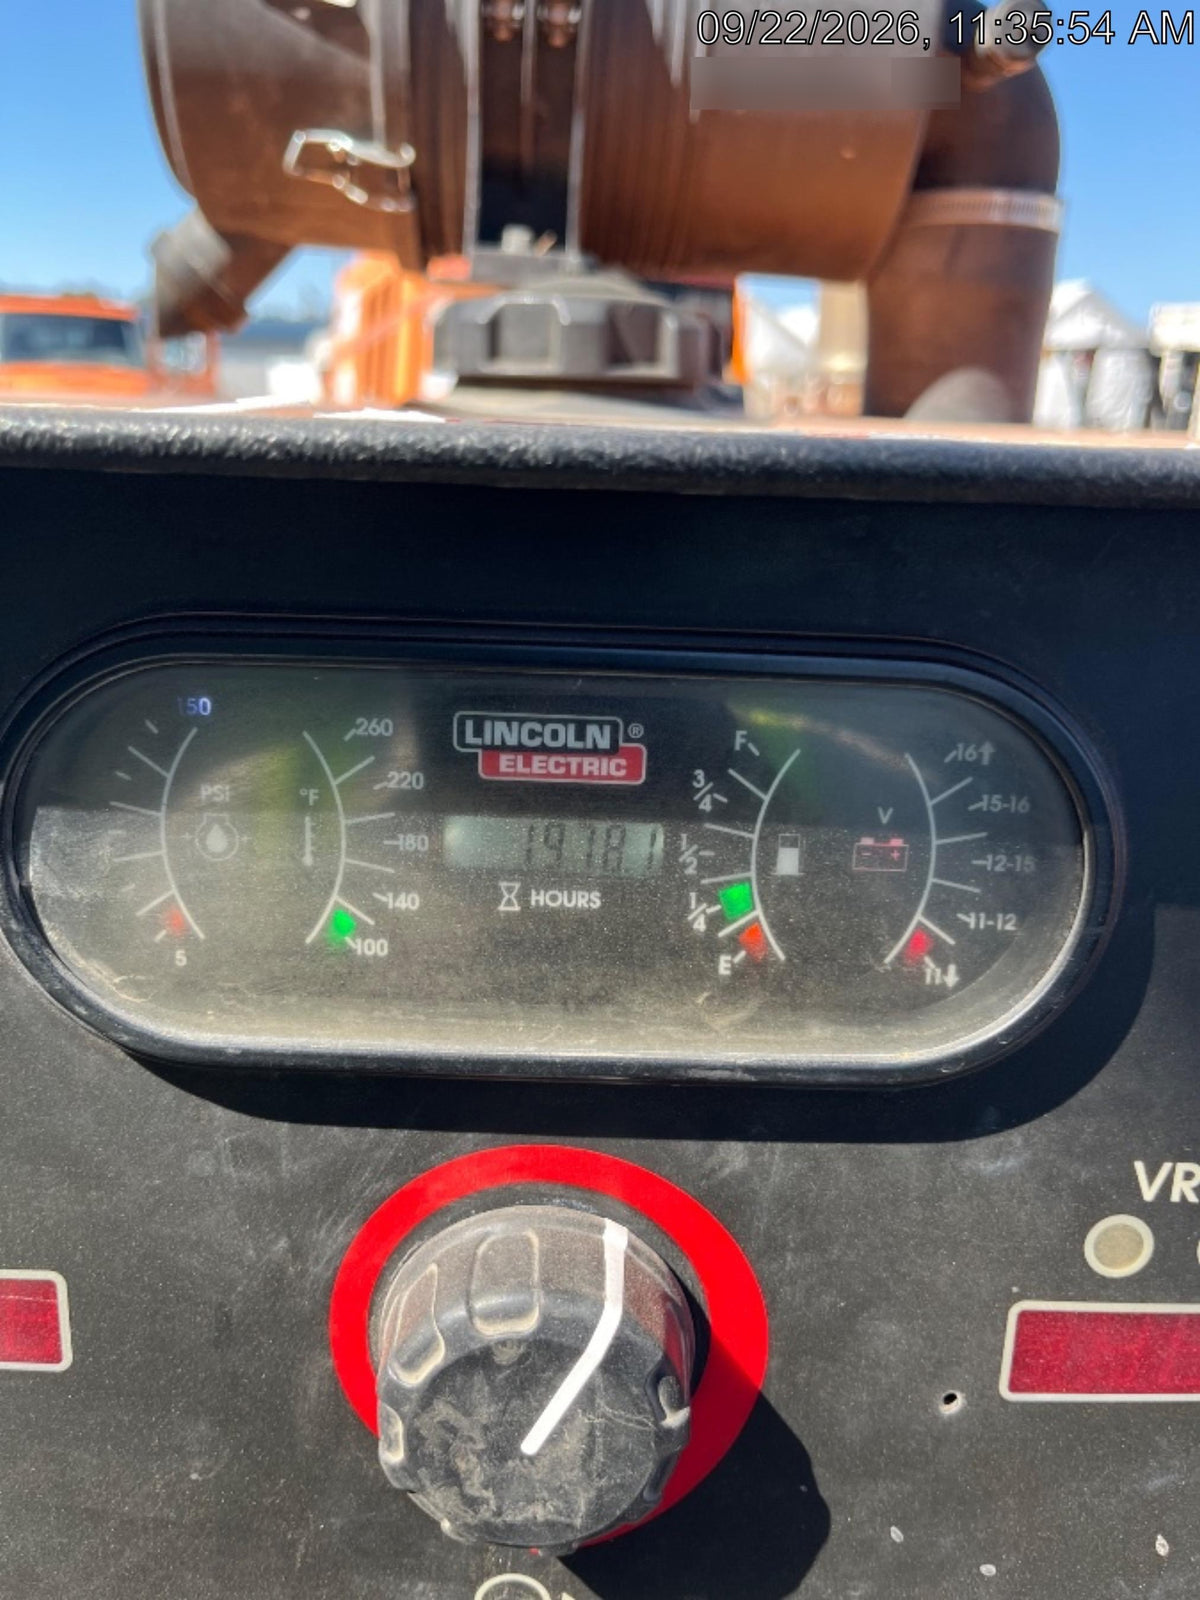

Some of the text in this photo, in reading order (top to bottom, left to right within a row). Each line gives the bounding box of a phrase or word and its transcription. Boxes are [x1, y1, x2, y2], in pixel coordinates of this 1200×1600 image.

[355, 718, 394, 737] 260
[464, 718, 612, 750] LINCOLN
[733, 730, 748, 751] F
[498, 754, 628, 777] ELECTRIC
[386, 771, 425, 790] 220
[981, 794, 1031, 814] 15-16
[877, 806, 894, 825] V
[398, 833, 429, 851] 180
[986, 853, 1036, 873] 12-15
[385, 892, 420, 911] 140
[530, 888, 602, 910] HOURS
[353, 938, 389, 957] 100
[175, 950, 188, 967] 5
[717, 955, 733, 976] E
